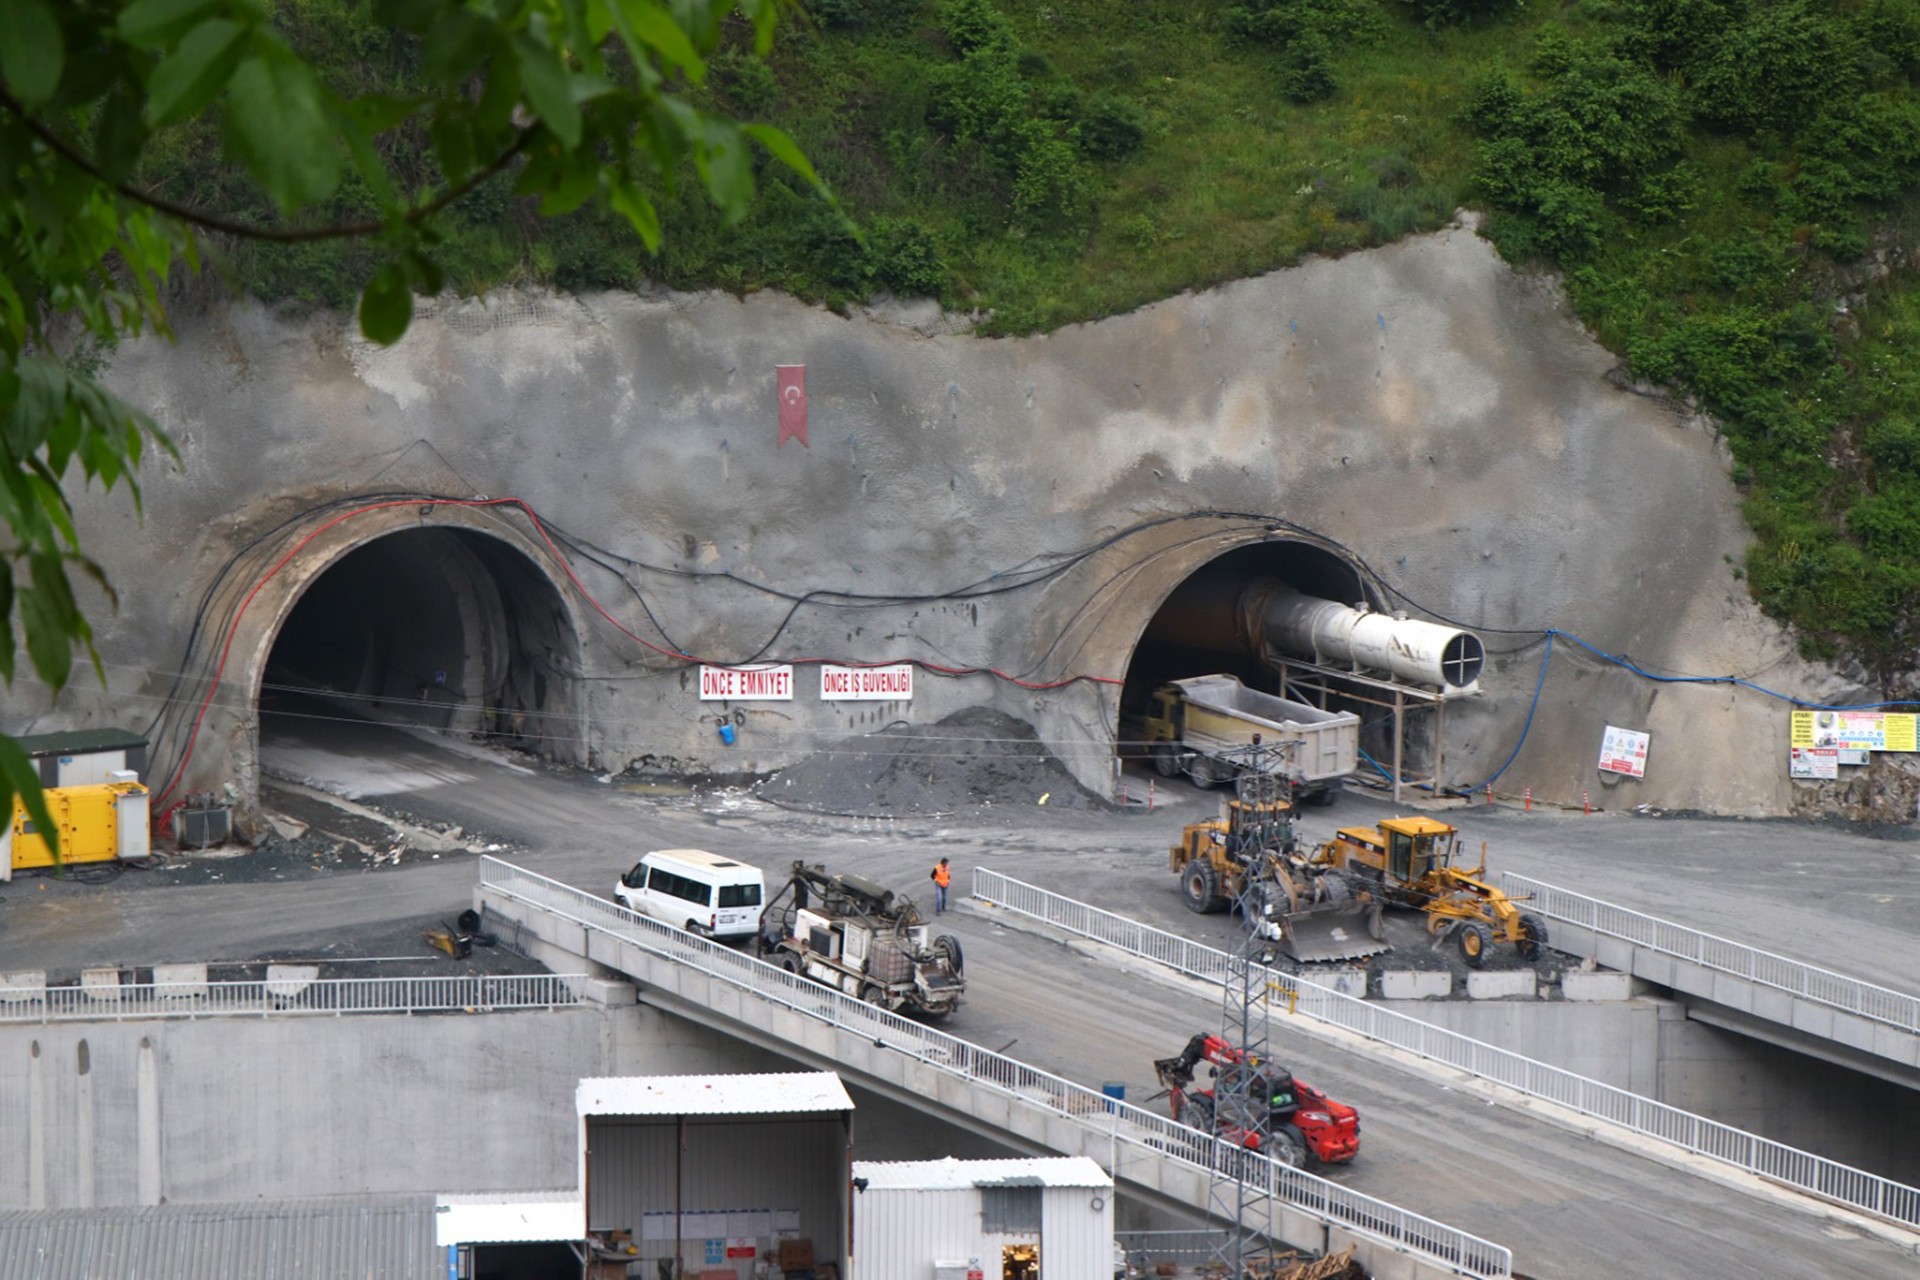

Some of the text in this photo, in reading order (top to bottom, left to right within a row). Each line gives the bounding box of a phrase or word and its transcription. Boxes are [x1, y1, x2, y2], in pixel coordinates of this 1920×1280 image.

[704, 667, 733, 695] ÖNCE
[824, 668, 910, 698] ÖNCE İŞ GÜVENLİĞİ
